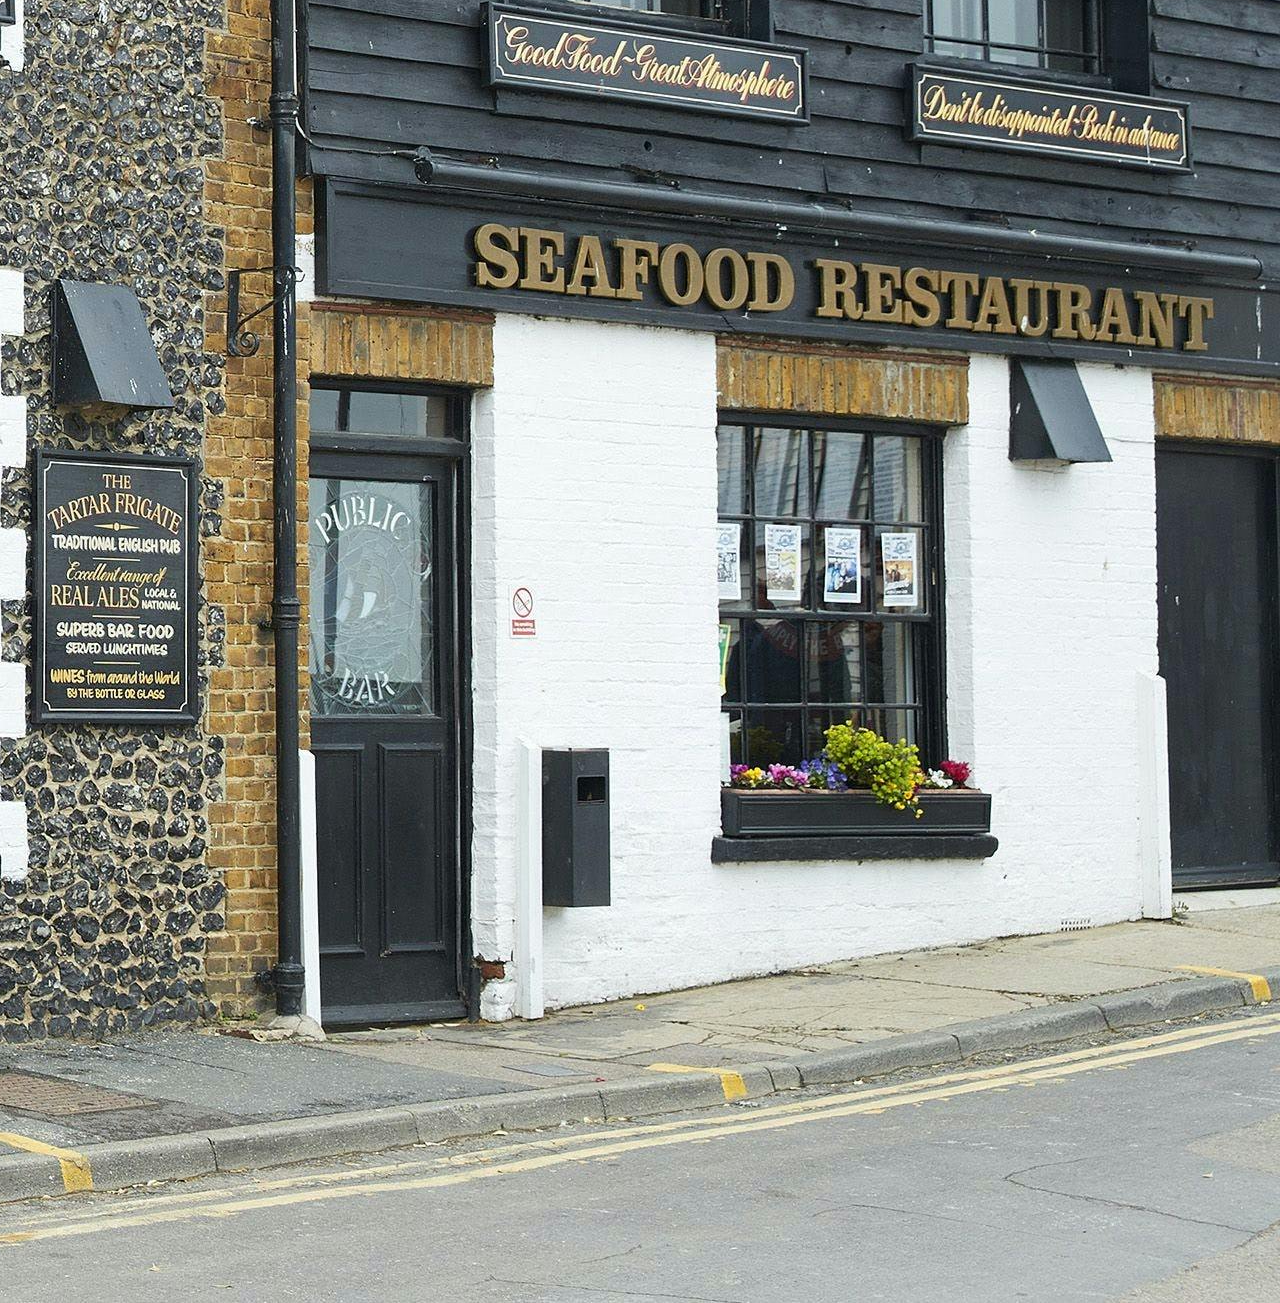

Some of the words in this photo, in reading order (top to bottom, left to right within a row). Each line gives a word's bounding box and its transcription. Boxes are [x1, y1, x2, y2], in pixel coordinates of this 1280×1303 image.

[504, 22, 567, 69] Good
[560, 33, 627, 77] Food
[632, 40, 692, 81] Great
[683, 53, 794, 101] Atmosphere
[968, 91, 984, 125] be
[983, 94, 1077, 137] disappointed
[1074, 103, 1116, 142] Book
[1114, 117, 1128, 143] in
[474, 223, 796, 313] SEAFOOD
[813, 257, 1215, 352] RESTAURANT
[102, 473, 132, 490] THE
[47, 492, 112, 531] TARTAR
[115, 492, 183, 536] FRIGATE
[315, 496, 411, 544] PUBLIC
[51, 534, 118, 553] TRADITIONAL
[118, 537, 159, 554] ENGLISH
[159, 539, 181, 555] PUB
[66, 556, 120, 582] Excellent
[119, 567, 154, 588] range
[153, 566, 167, 588] of
[50, 584, 94, 607] REAL
[97, 586, 140, 609] ALES
[144, 587, 169, 599] LOCAL
[169, 588, 177, 599] &
[141, 599, 181, 611] NATIONAL
[56, 621, 106, 638] SUPERB
[107, 623, 135, 639] BAR
[139, 624, 175, 639] FOOD
[65, 641, 101, 655] SERVED
[103, 643, 168, 656] LUNCHTIMES
[50, 668, 86, 684] WINES
[85, 670, 106, 685] from
[106, 670, 139, 685] around
[139, 669, 154, 685] the
[154, 670, 180, 686] World
[339, 667, 396, 704] BAR
[78, 688, 94, 698] THE
[95, 688, 123, 699] BOTTLE
[124, 688, 136, 699] OR
[137, 689, 165, 700] GLASS
